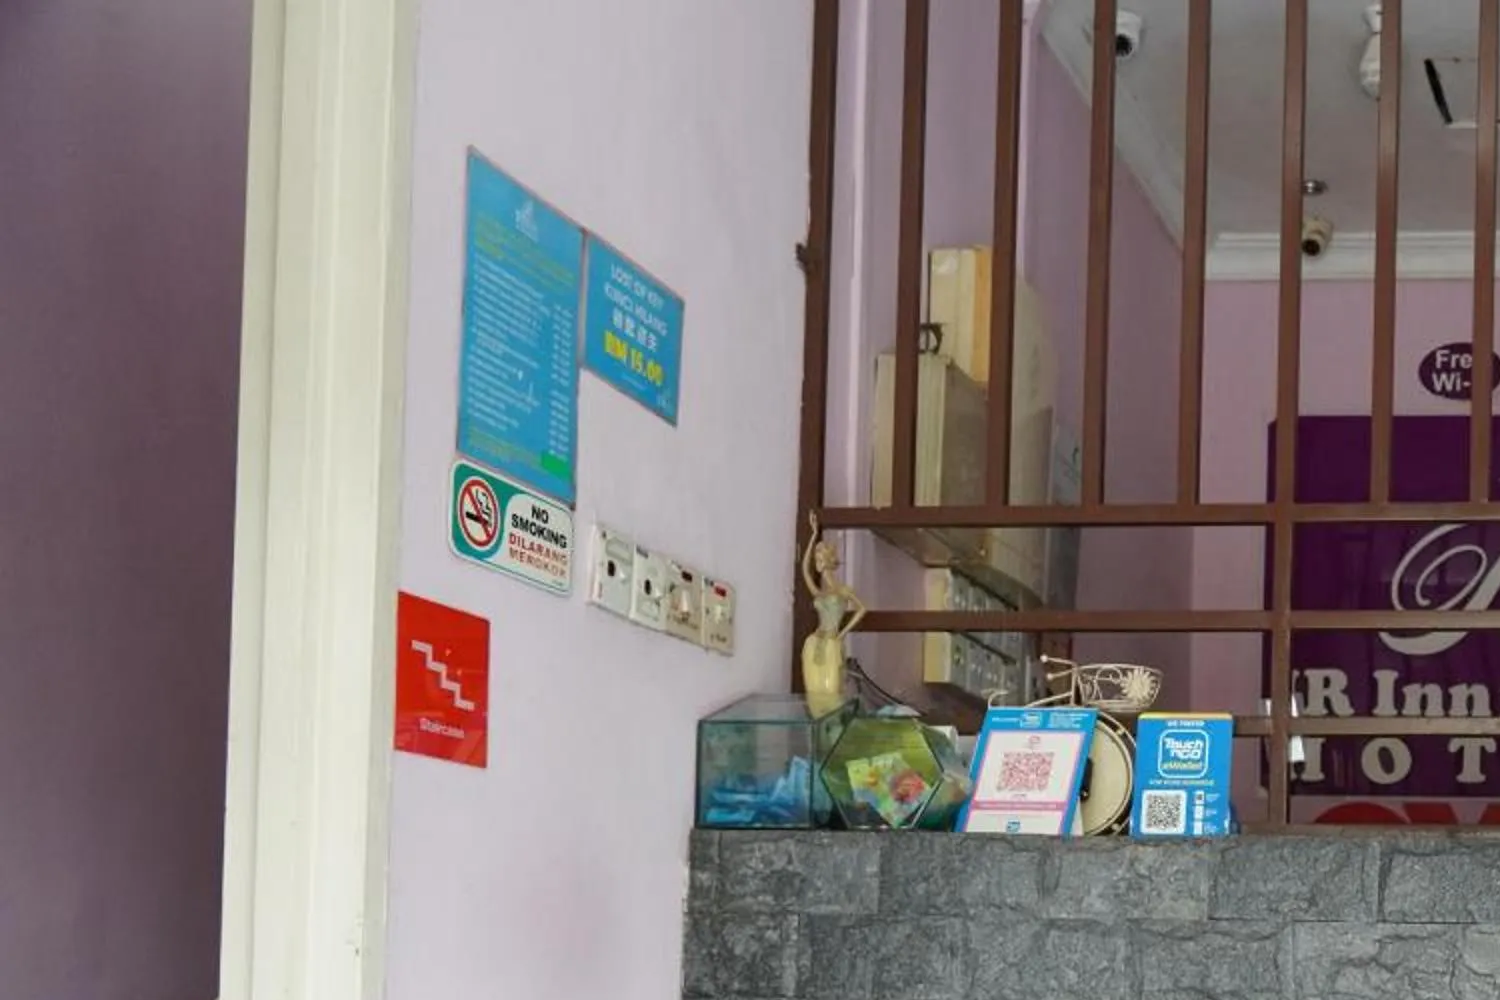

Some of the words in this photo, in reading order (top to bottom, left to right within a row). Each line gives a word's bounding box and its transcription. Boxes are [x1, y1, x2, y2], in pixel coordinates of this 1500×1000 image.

[1435, 349, 1473, 369] Fre
[1432, 371, 1472, 392] Wi-
[531, 504, 549, 524] NO
[511, 513, 567, 549] SMOKING
[509, 532, 568, 566] DILARANG
[1372, 669, 1492, 717] Inn
